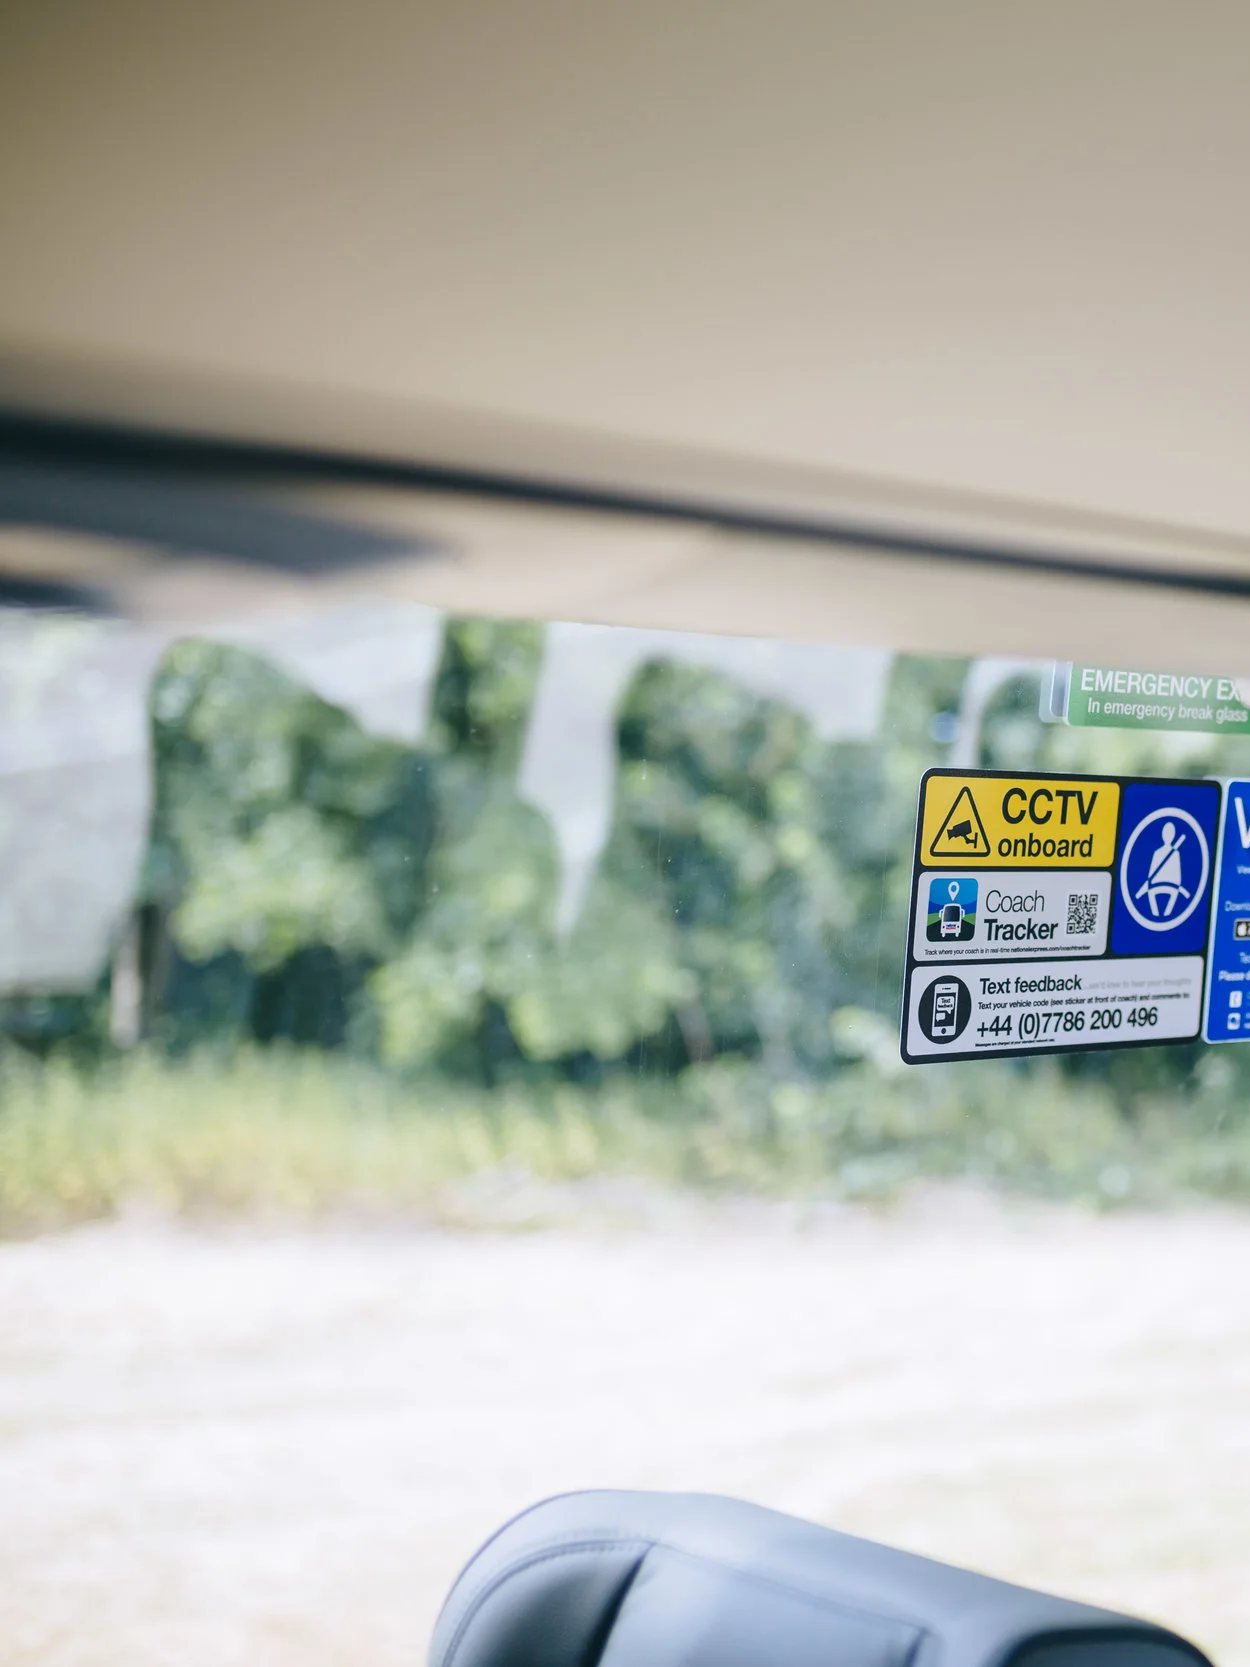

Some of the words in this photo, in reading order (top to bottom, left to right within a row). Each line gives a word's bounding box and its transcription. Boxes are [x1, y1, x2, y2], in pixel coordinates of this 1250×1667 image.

[1081, 668, 1213, 699] EMERGENCY
[1216, 679, 1242, 701] EX
[1087, 697, 1100, 714] In
[1104, 702, 1176, 722] emergency
[1178, 706, 1213, 721] break
[1216, 708, 1248, 725] glass
[1002, 787, 1098, 825] CCTV
[998, 833, 1094, 857] onboard
[985, 890, 1045, 913] Coach
[984, 918, 1059, 941] Tracker
[980, 978, 1011, 995] Text
[1014, 974, 1082, 993] feedback
[978, 1001, 992, 1010] Text
[992, 1002, 1008, 1011] your
[1009, 999, 1032, 1008] vehicle
[1032, 999, 1049, 1007] code
[1065, 997, 1086, 1005] sticker
[1095, 995, 1109, 1003] front
[1110, 995, 1117, 1003] of
[977, 1015, 1012, 1037] +44
[1018, 1010, 1085, 1040] (0)7786
[1090, 1009, 1122, 1031] 200
[1127, 1006, 1158, 1028] 496
